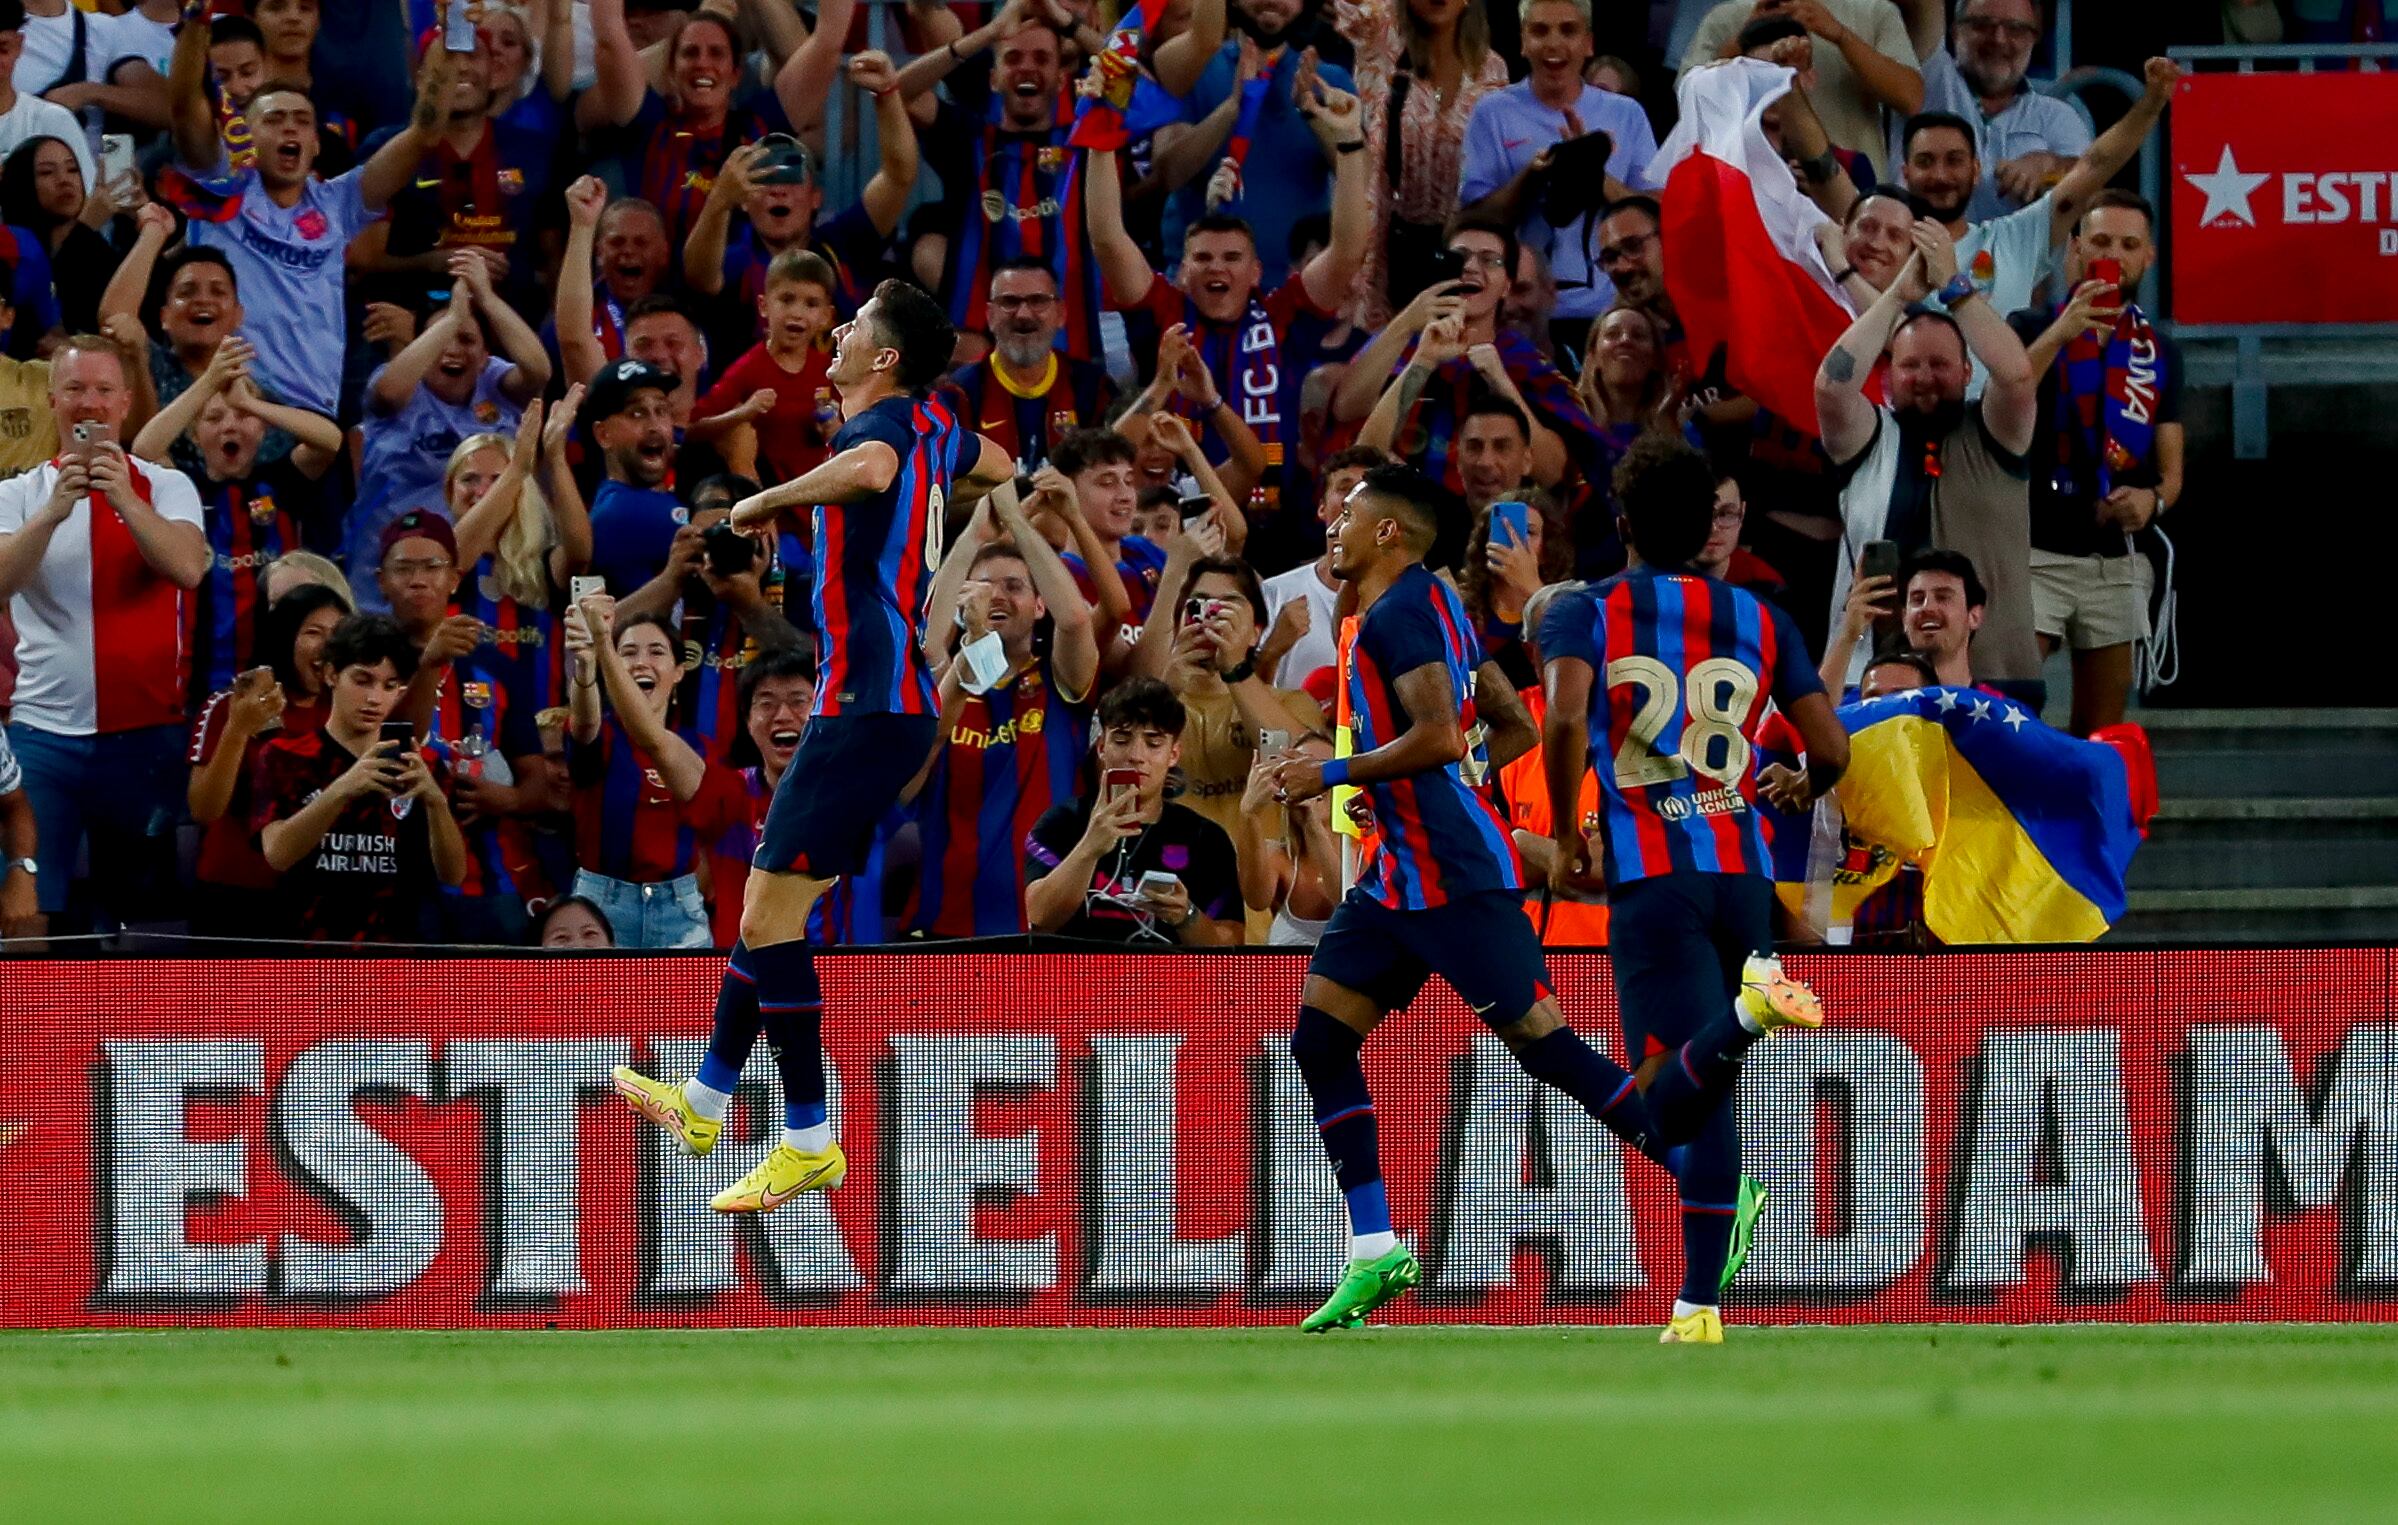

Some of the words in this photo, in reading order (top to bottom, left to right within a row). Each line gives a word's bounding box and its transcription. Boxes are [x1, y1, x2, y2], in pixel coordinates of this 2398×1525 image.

[2282, 171, 2398, 224] EST
[1606, 655, 1759, 790] 28
[320, 832, 397, 853] TURKISH
[315, 853, 398, 874] AIRLINES
